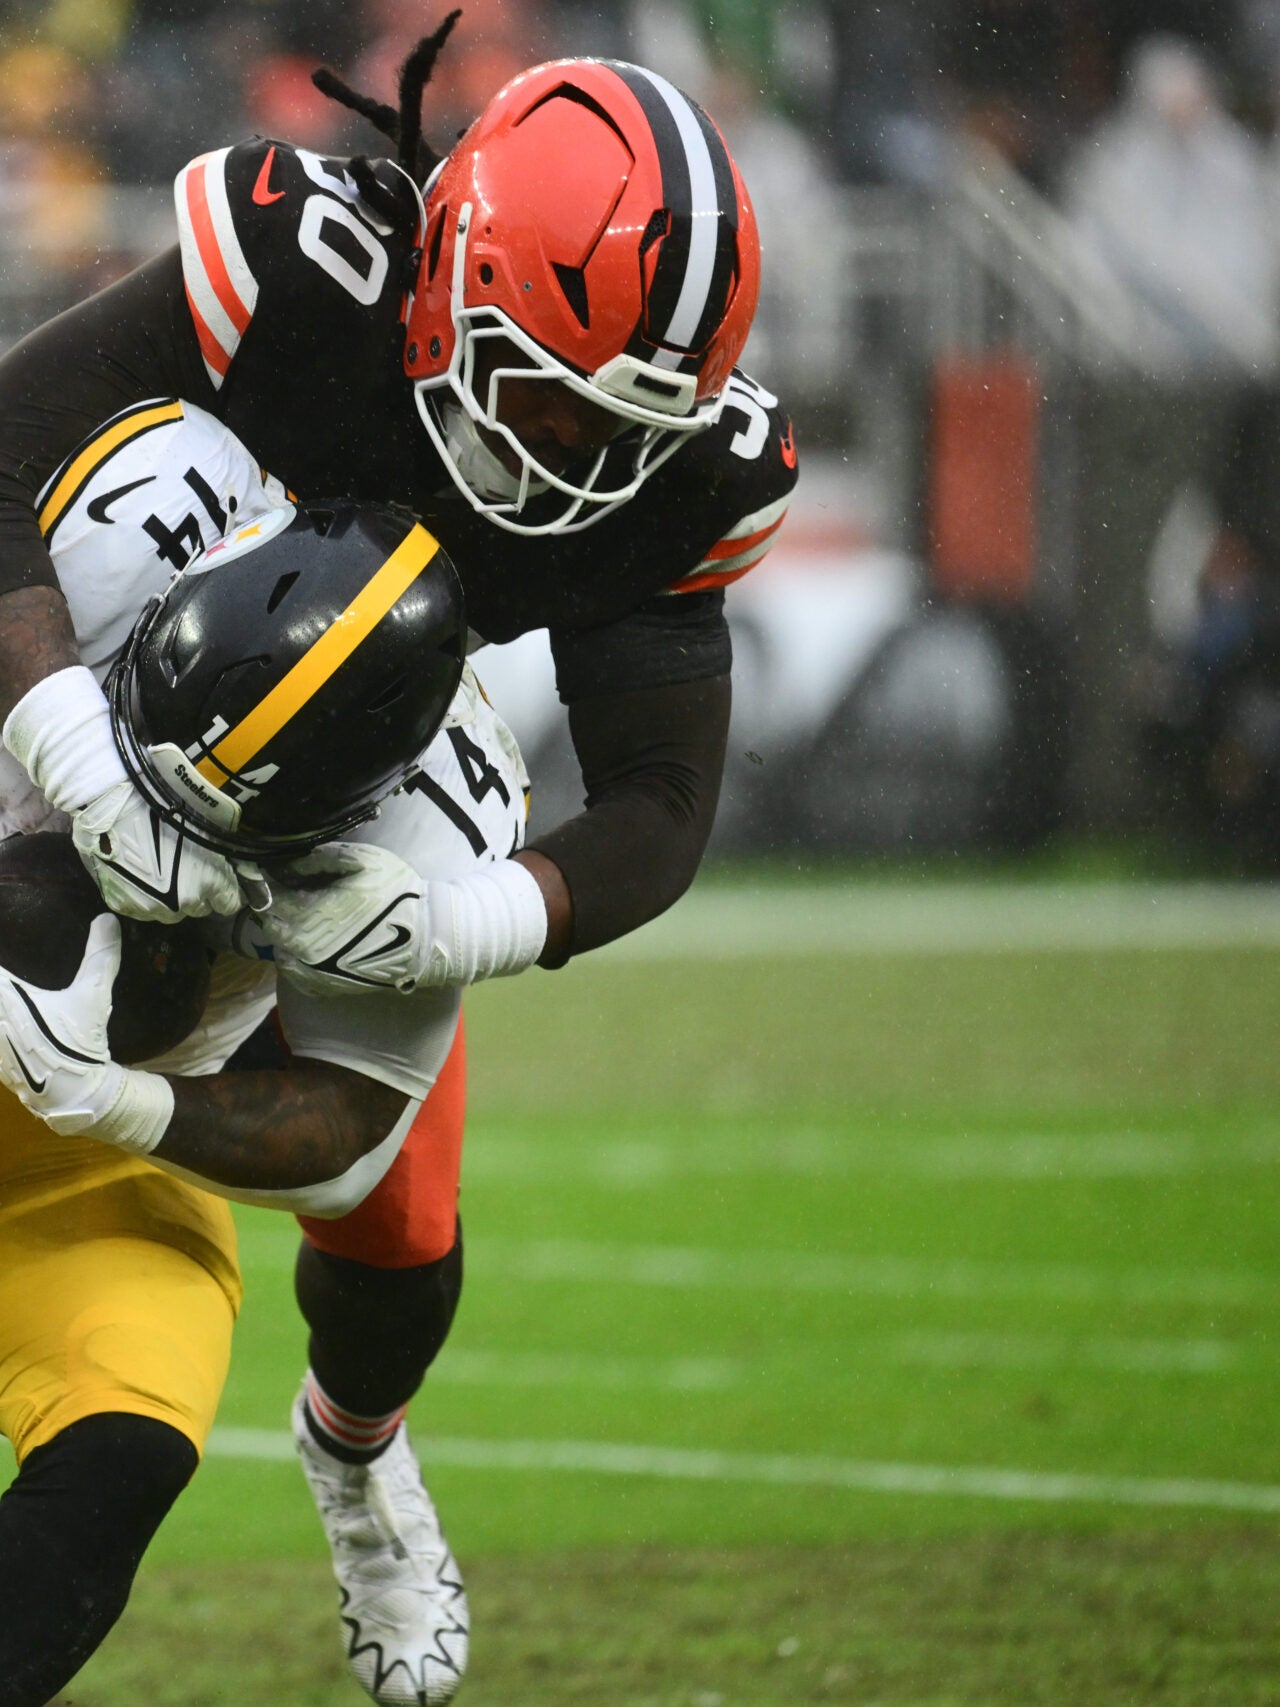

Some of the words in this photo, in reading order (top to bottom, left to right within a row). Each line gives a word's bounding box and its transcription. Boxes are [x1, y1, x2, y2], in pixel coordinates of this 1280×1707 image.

[142, 466, 227, 571] 14
[174, 764, 219, 808] Steelers
[184, 714, 280, 803] 14
[402, 726, 510, 858] 14
